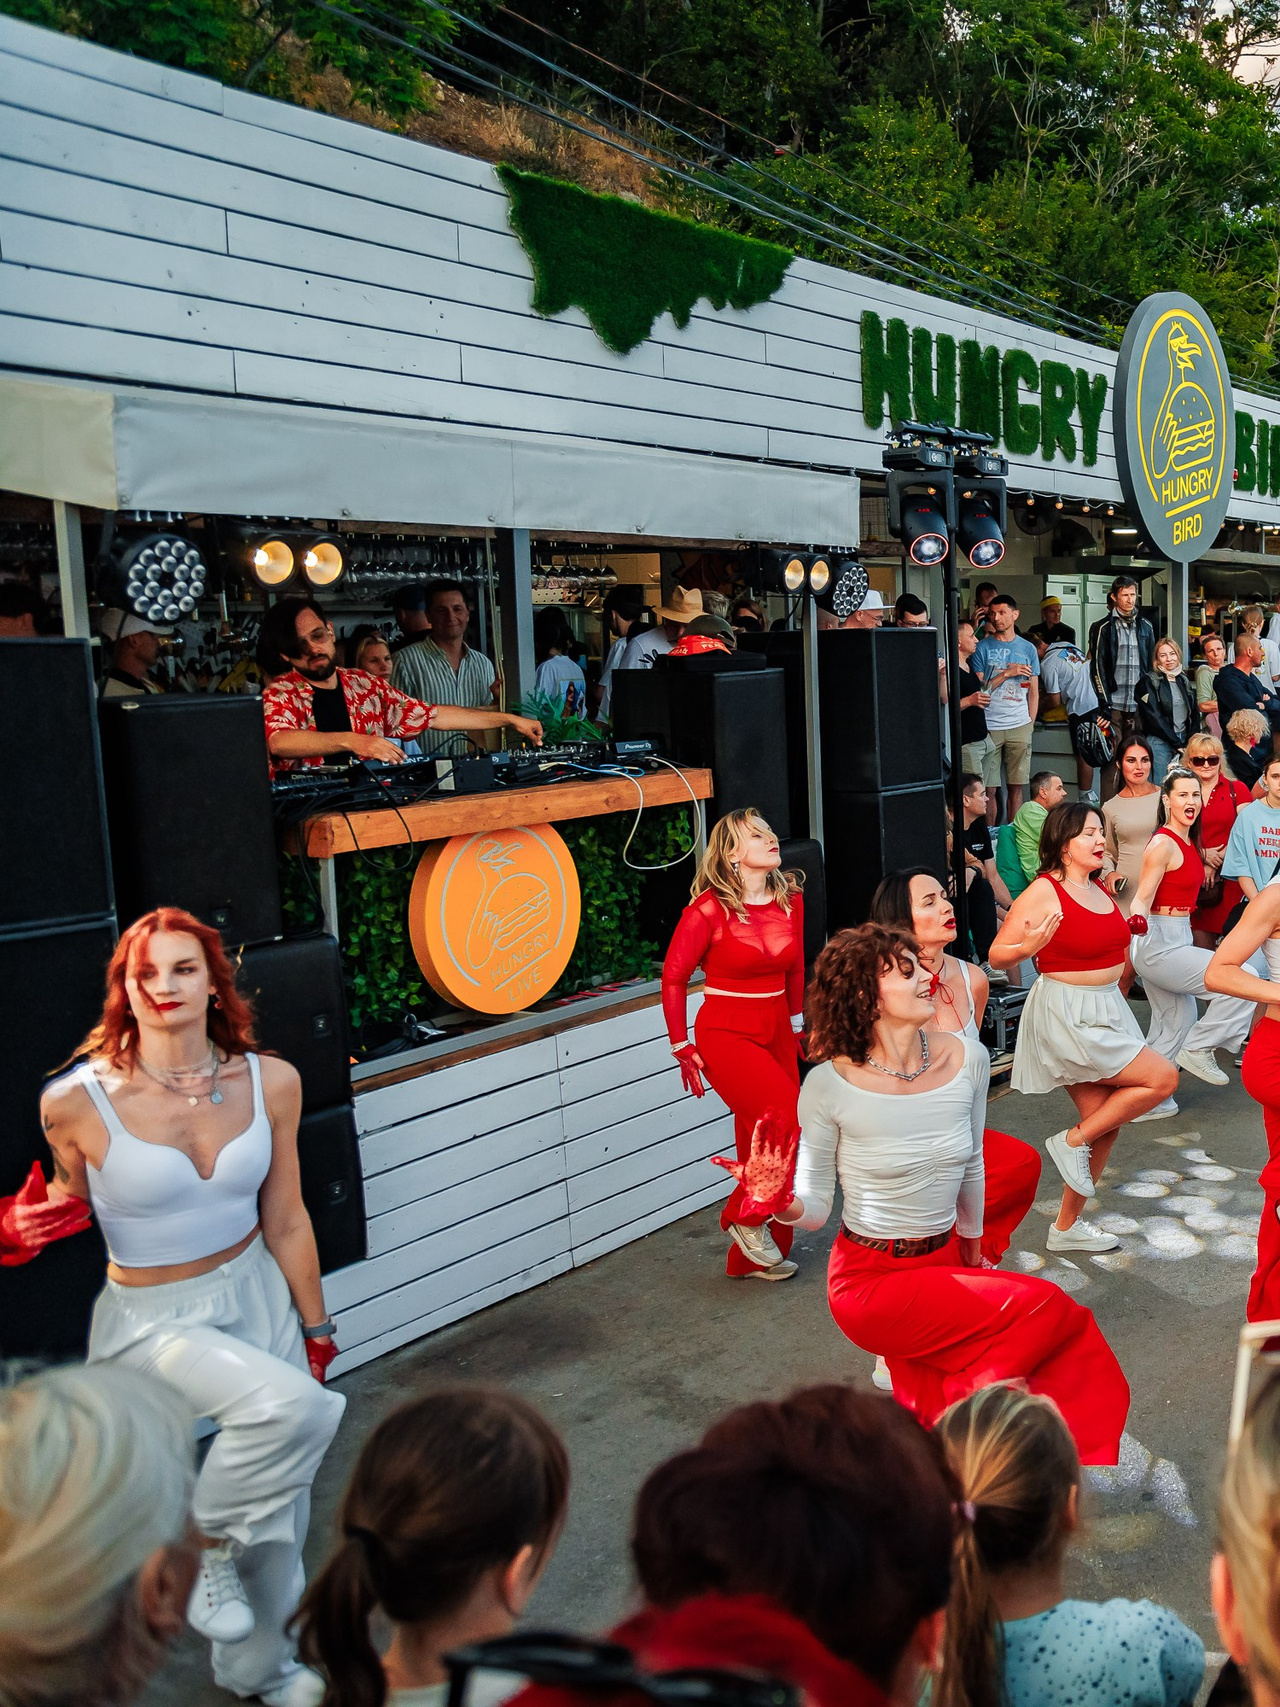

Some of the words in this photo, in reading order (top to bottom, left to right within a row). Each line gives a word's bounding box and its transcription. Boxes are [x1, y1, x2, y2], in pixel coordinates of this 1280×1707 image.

[861, 310, 1107, 466] HUNGRY
[1161, 466, 1213, 505] HUNGRY
[1173, 513, 1202, 545] BIRD
[1260, 849, 1280, 858] MIN
[490, 929, 550, 983] HUNGRY
[508, 965, 542, 1002] LIVE
